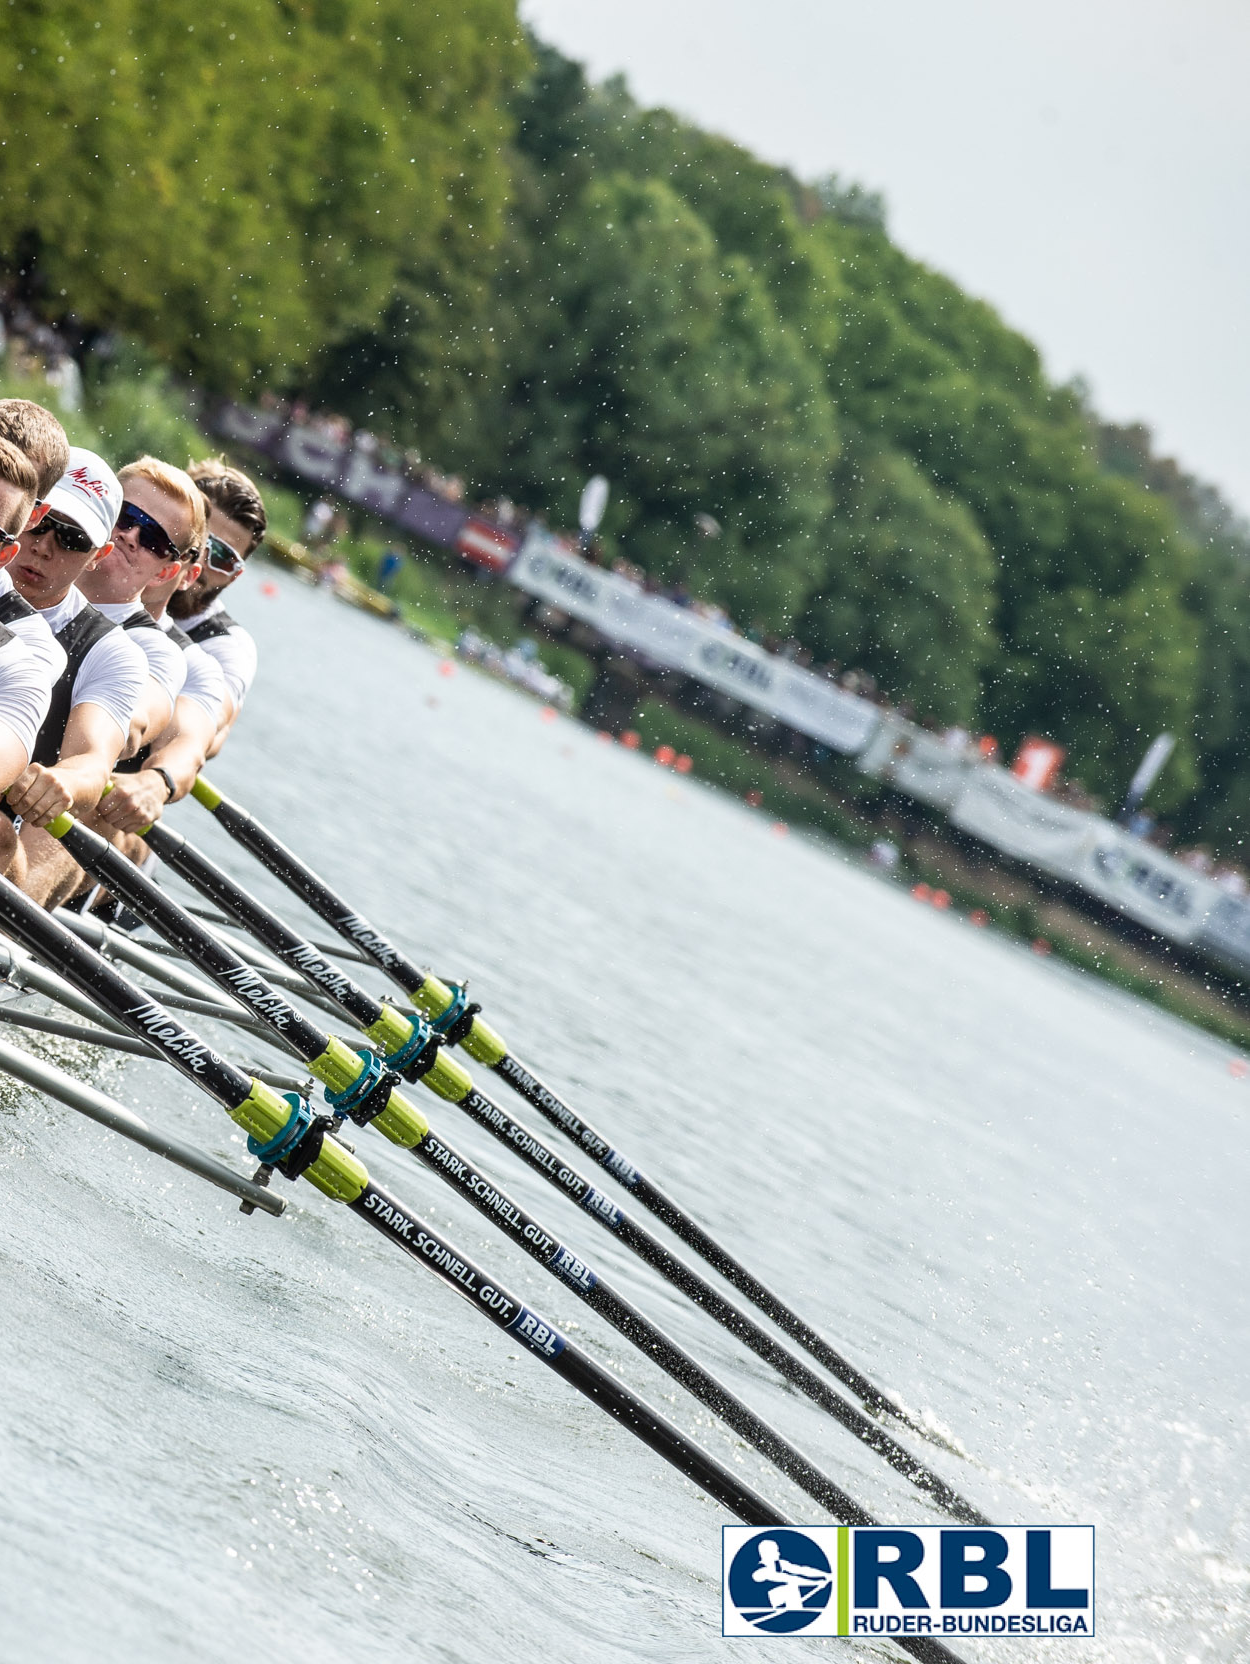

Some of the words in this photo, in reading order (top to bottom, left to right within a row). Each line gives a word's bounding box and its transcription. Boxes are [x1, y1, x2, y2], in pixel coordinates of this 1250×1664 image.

[424, 1138, 468, 1181] STARK.
[466, 1174, 522, 1230] SCHNELL.
[523, 1224, 553, 1254] GUT.
[558, 1250, 590, 1286] RBL
[469, 1094, 507, 1132] STARK.
[506, 1125, 556, 1174] SCHNELL.
[557, 1168, 585, 1195] GUT.
[589, 1190, 618, 1222] RBL
[610, 1152, 636, 1183] RBL
[364, 1193, 414, 1240] STARK.
[412, 1232, 477, 1292] SCHNELL.
[479, 1285, 513, 1319] GUT.
[519, 1314, 556, 1354] RBL
